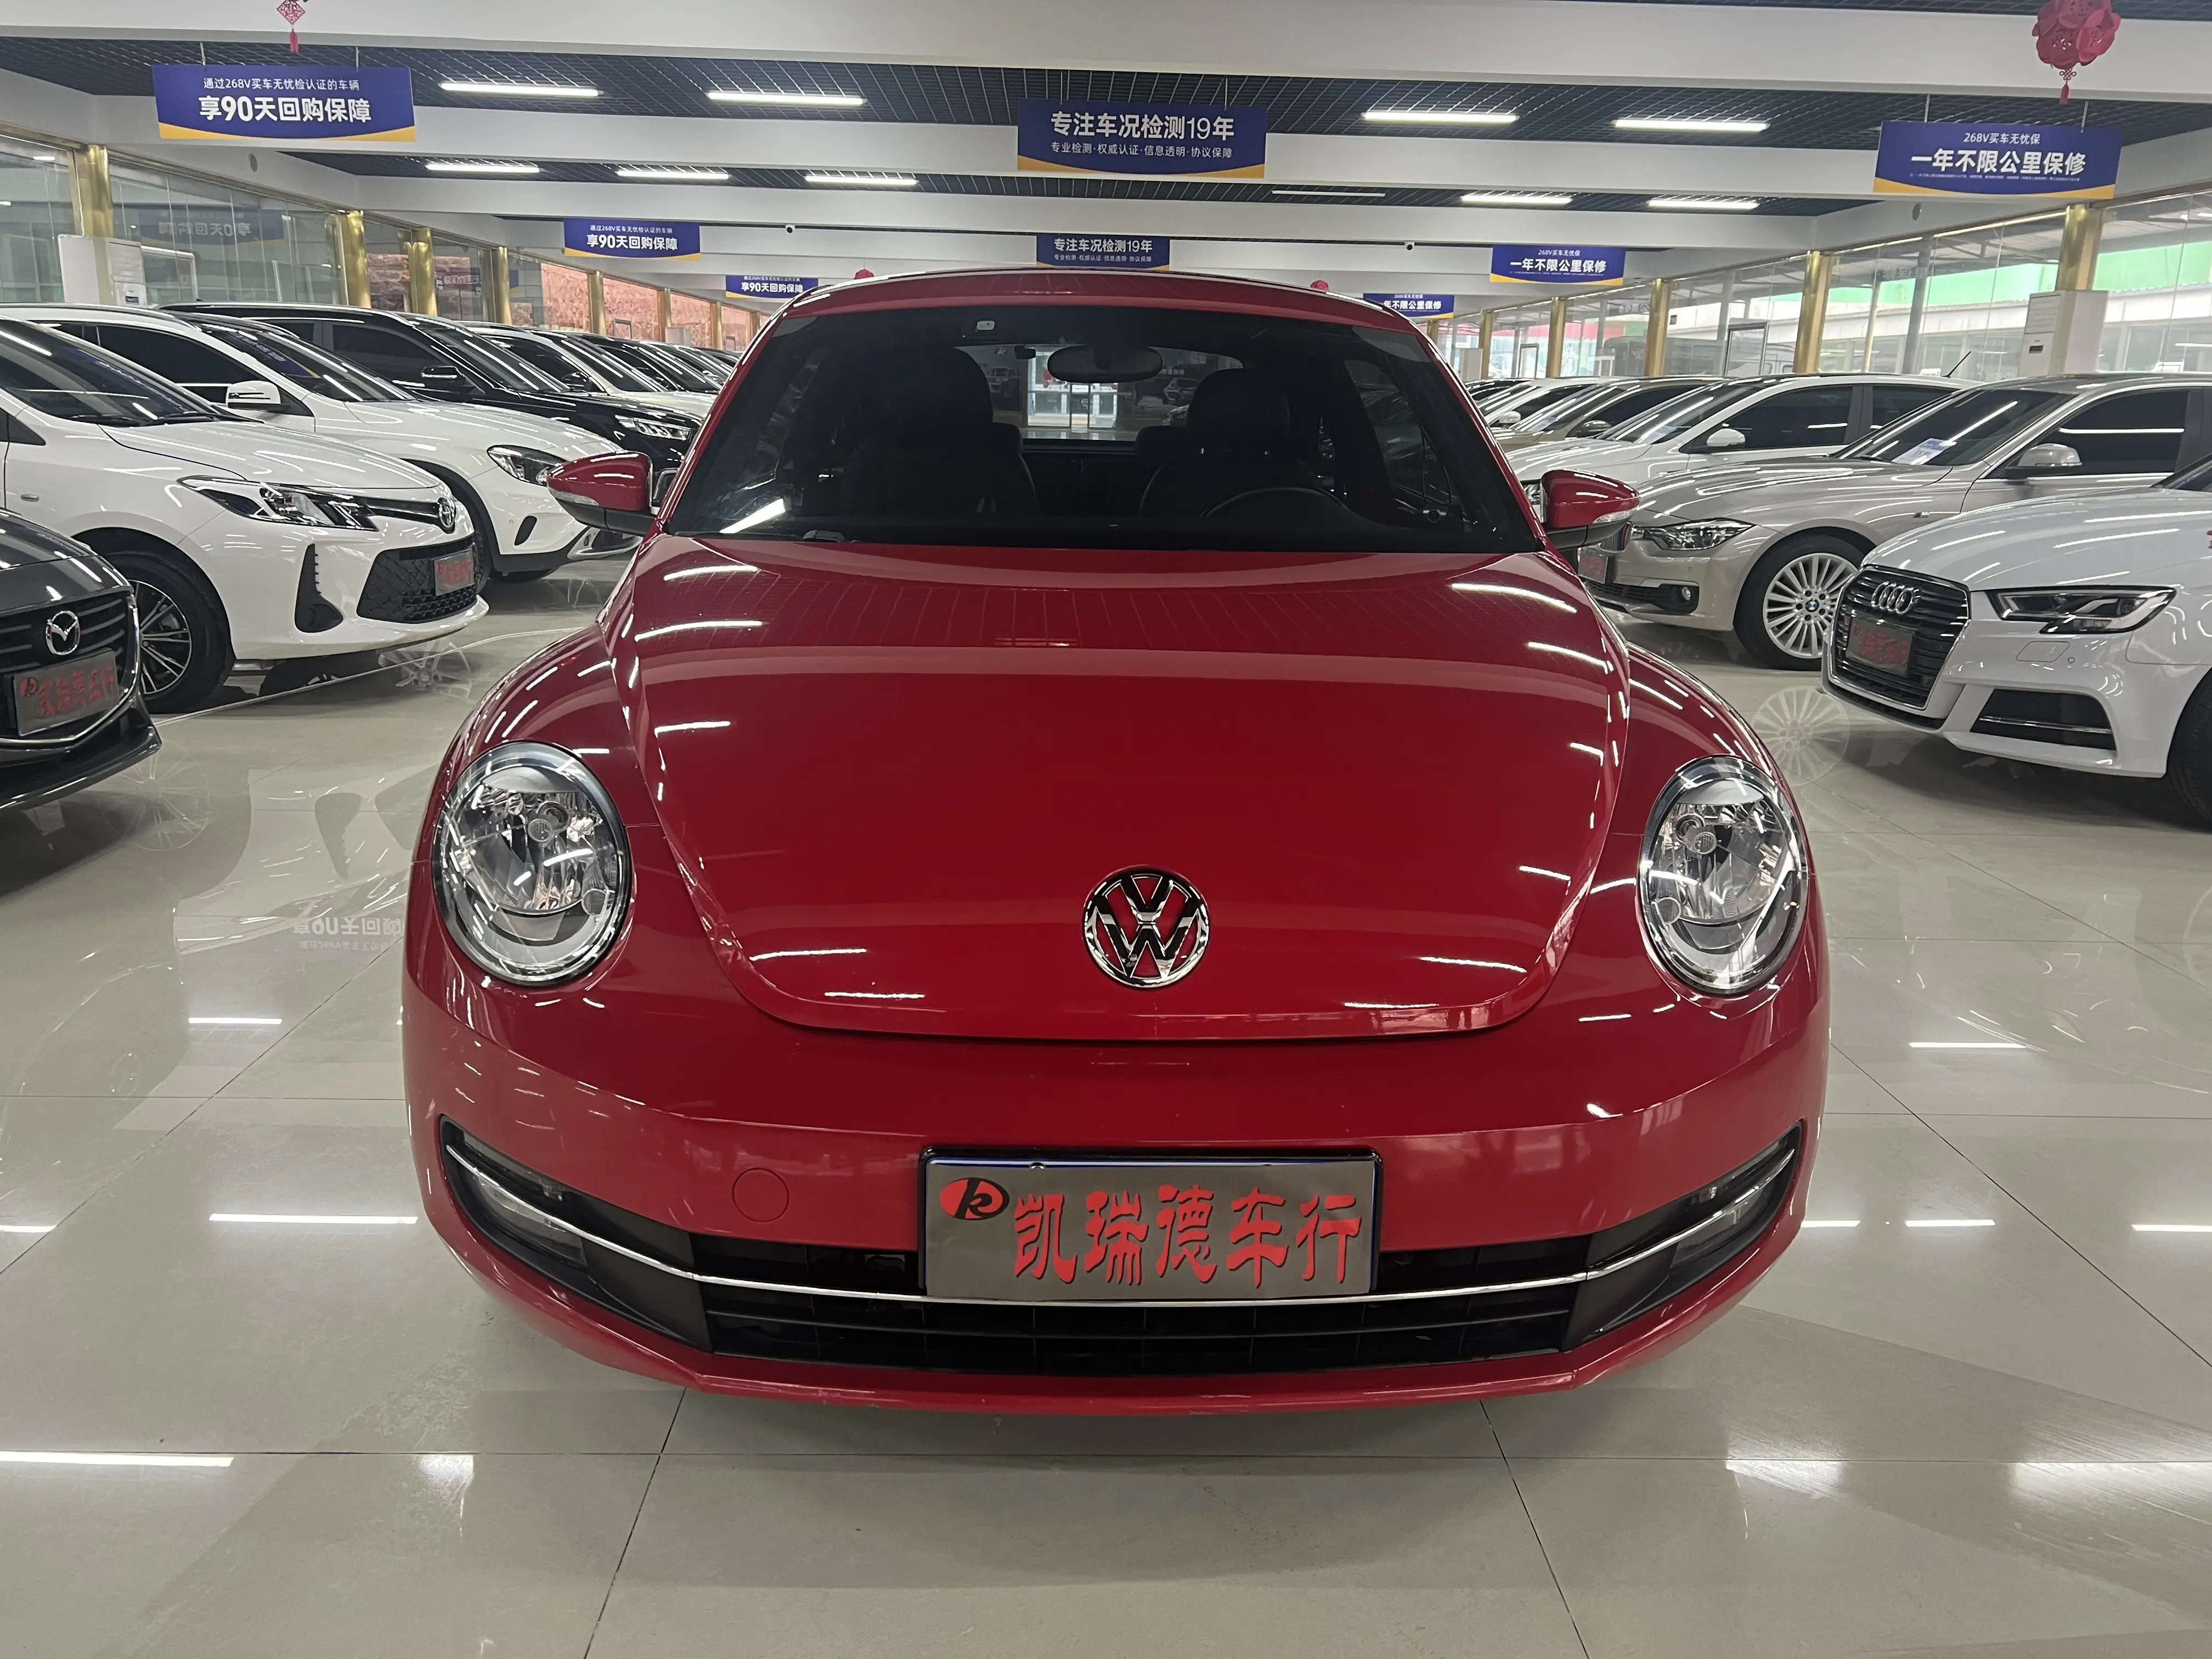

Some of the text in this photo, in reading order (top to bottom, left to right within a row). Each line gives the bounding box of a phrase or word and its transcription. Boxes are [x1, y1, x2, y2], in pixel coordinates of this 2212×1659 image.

[203, 77, 360, 91] 通过268V买车无忧检认证的车辆
[198, 95, 371, 123] 享90天回购保障
[1051, 111, 1234, 141] 专注车况检测19年
[1963, 132, 2041, 145] 268V买车无忧保
[1911, 148, 2086, 175] 一年不限公里保修
[586, 234, 678, 251] 享90天回购保障
[1054, 238, 1153, 253] 专注车况检测19年
[1510, 258, 1606, 273] 一年不限公里保修
[741, 281, 803, 293] 享90天回购保障
[1082, 866, 1210, 989] VW
[1014, 1184, 1362, 1289] 凯瑞德车行
